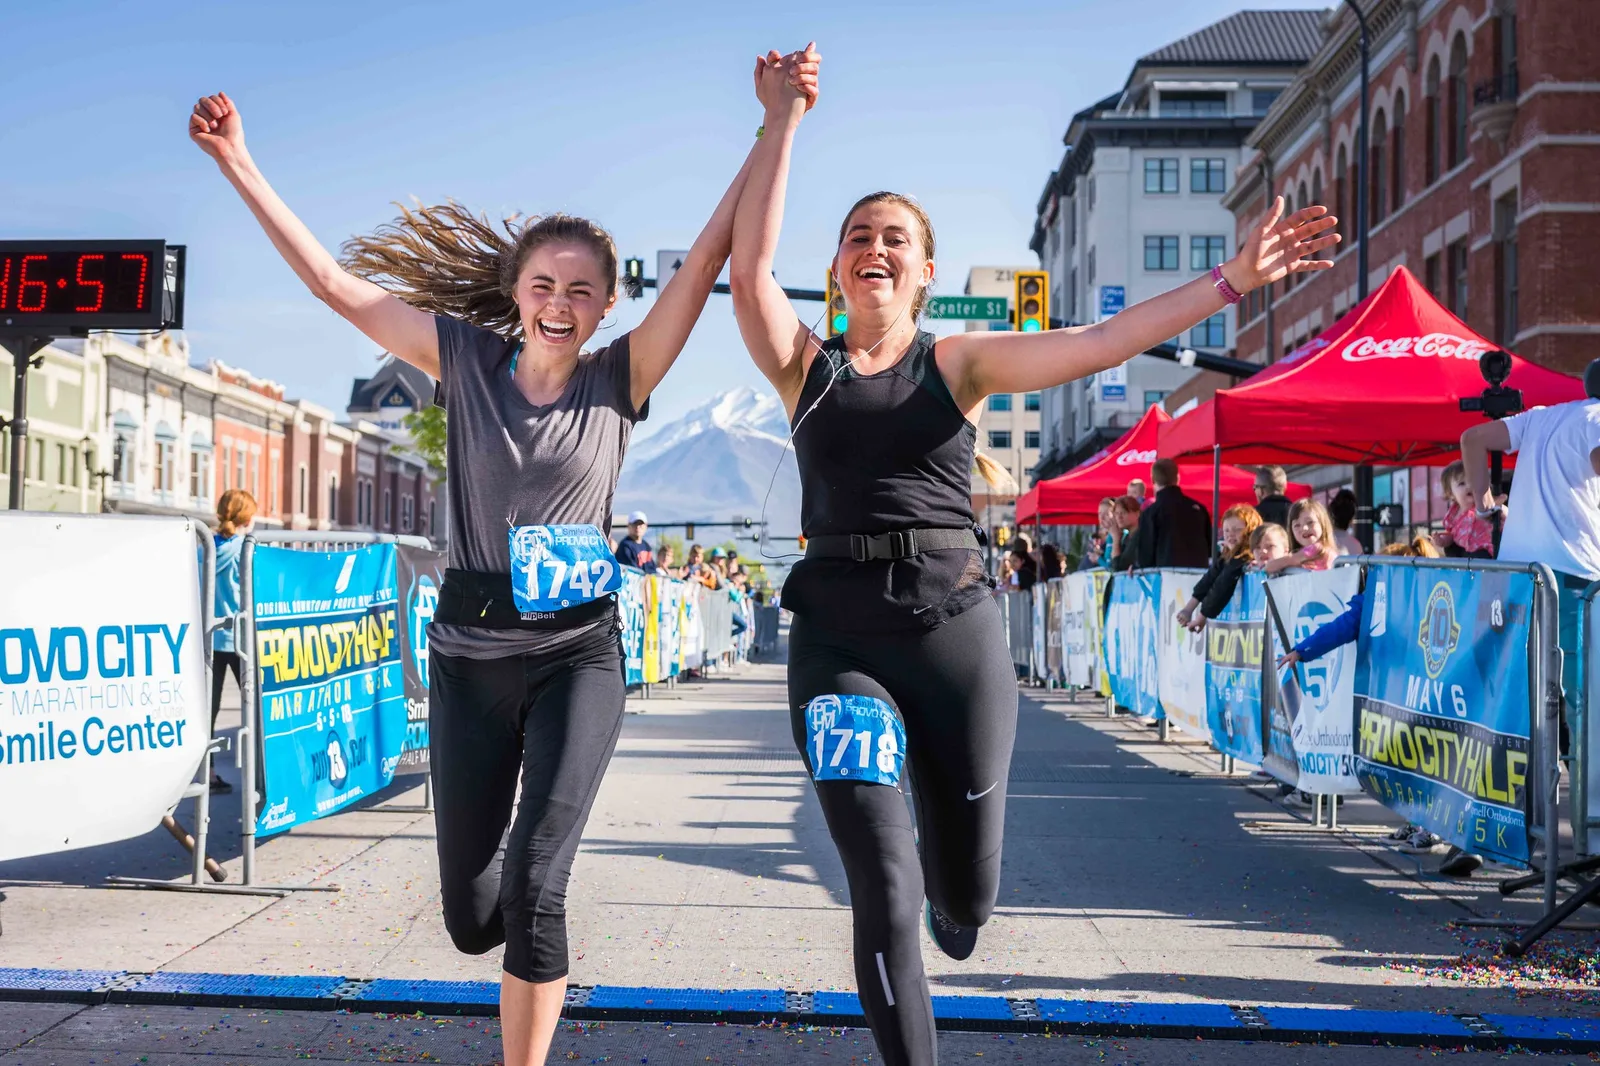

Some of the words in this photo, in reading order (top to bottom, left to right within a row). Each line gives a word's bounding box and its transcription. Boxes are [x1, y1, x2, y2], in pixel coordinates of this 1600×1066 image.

[929, 300, 977, 316] Center
[987, 301, 1001, 316] St
[521, 560, 614, 600] 1742
[0, 626, 89, 684] OVO
[97, 623, 190, 679] CITY
[12, 683, 134, 716] MARATHON
[140, 682, 153, 706] &
[159, 680, 185, 704] 5K
[1405, 674, 1444, 714] MAY
[1451, 684, 1467, 718] 6
[83, 715, 186, 756] Center
[813, 728, 898, 775] 1718
